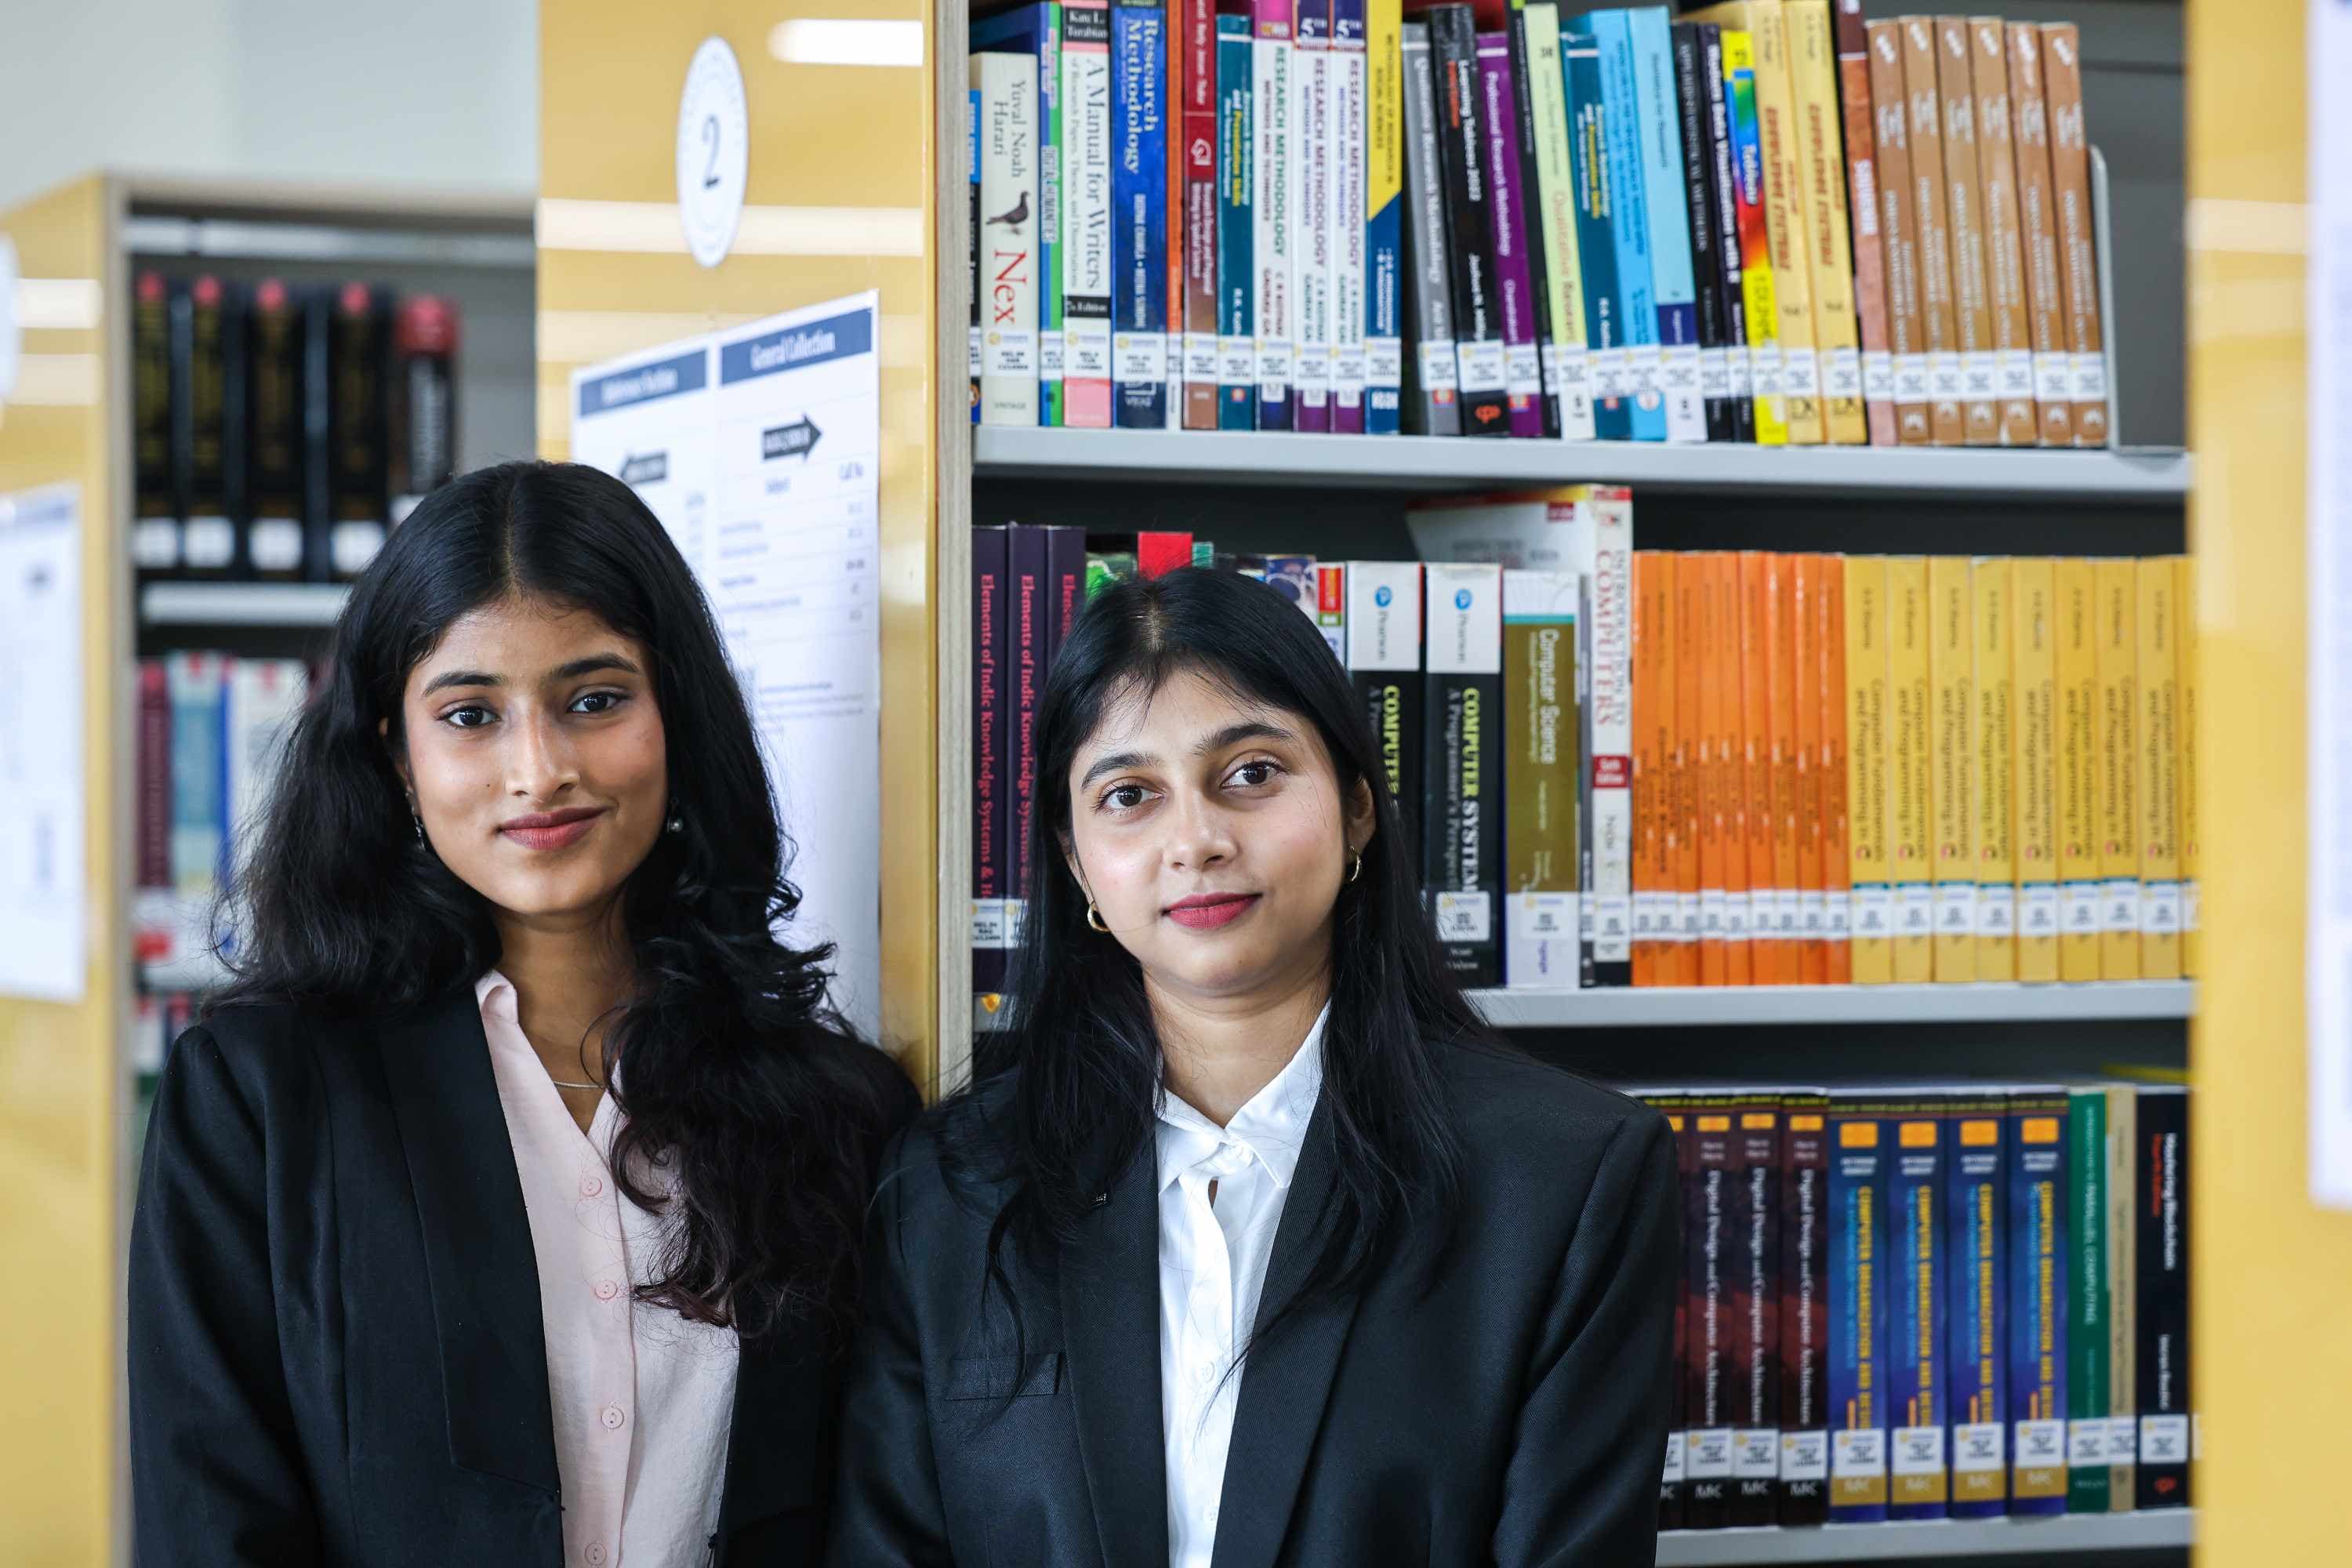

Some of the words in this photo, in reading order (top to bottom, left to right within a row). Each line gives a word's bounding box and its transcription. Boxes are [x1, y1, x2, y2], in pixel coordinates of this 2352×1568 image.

[1087, 59, 1104, 77] A
[1124, 20, 1144, 173] Methodology
[1143, 19, 1160, 132] Research
[1275, 47, 1285, 128] RESEARCH
[1315, 59, 1324, 140] RESEARCH
[1457, 60, 1474, 118] Learning
[1707, 45, 1724, 102] Modern
[993, 101, 1008, 157] Harari
[1010, 80, 1026, 124] Yuval
[1087, 85, 1105, 166] Manual
[1349, 60, 1359, 141] RESEARCH
[1484, 71, 1501, 136] Professional
[1711, 102, 1727, 140] Data
[702, 114, 722, 189] 2
[1011, 132, 1026, 177] Noah
[1421, 133, 1438, 193] Research
[1462, 119, 1478, 169] Tableau
[1491, 138, 1506, 186] Research
[1087, 173, 1106, 204] for
[1275, 135, 1286, 257] METHODOLOGY
[1315, 145, 1324, 268] METHODOLOGY
[1349, 147, 1359, 269] METHODOLOGY
[1715, 141, 1736, 234] Visualization
[1087, 209, 1106, 289] Writers
[1495, 188, 1513, 257] Methodology
[1726, 236, 1740, 269] with
[994, 249, 1028, 325] Nex
[981, 574, 994, 645] Elements
[1021, 575, 1035, 647] Elements
[1596, 551, 1614, 726] COMPUTERS
[981, 649, 994, 666] of
[981, 669, 994, 707] Indic
[1021, 650, 1035, 666] of
[1021, 669, 1035, 707] Indic
[1538, 629, 1559, 703] Computer
[1449, 687, 1461, 700] A
[977, 712, 996, 797] Knowledge
[1018, 712, 1036, 797] Knowledge
[1461, 687, 1480, 797] COMPUTER
[1539, 706, 1561, 764] Science
[978, 801, 994, 862] Systems
[1018, 801, 1033, 863] Systems
[1461, 800, 1480, 892] SYSTEM
[981, 866, 994, 879] &
[1705, 1171, 1721, 1214] Digital
[1750, 1167, 1766, 1211] Digital
[1798, 1170, 1815, 1213] Digital
[1704, 1216, 1721, 1261] Design
[1749, 1213, 1766, 1257] Design
[1797, 1214, 1814, 1258] Design
[1704, 1282, 1720, 1345] Computer
[1749, 1279, 1766, 1342] Computer
[1798, 1279, 1814, 1344] Computer
[2083, 1246, 2099, 1325] COMPUTING
[1705, 1351, 1720, 1427] Architecture
[1751, 1348, 1766, 1424] Architecture
[1800, 1348, 1814, 1425] Architecture
